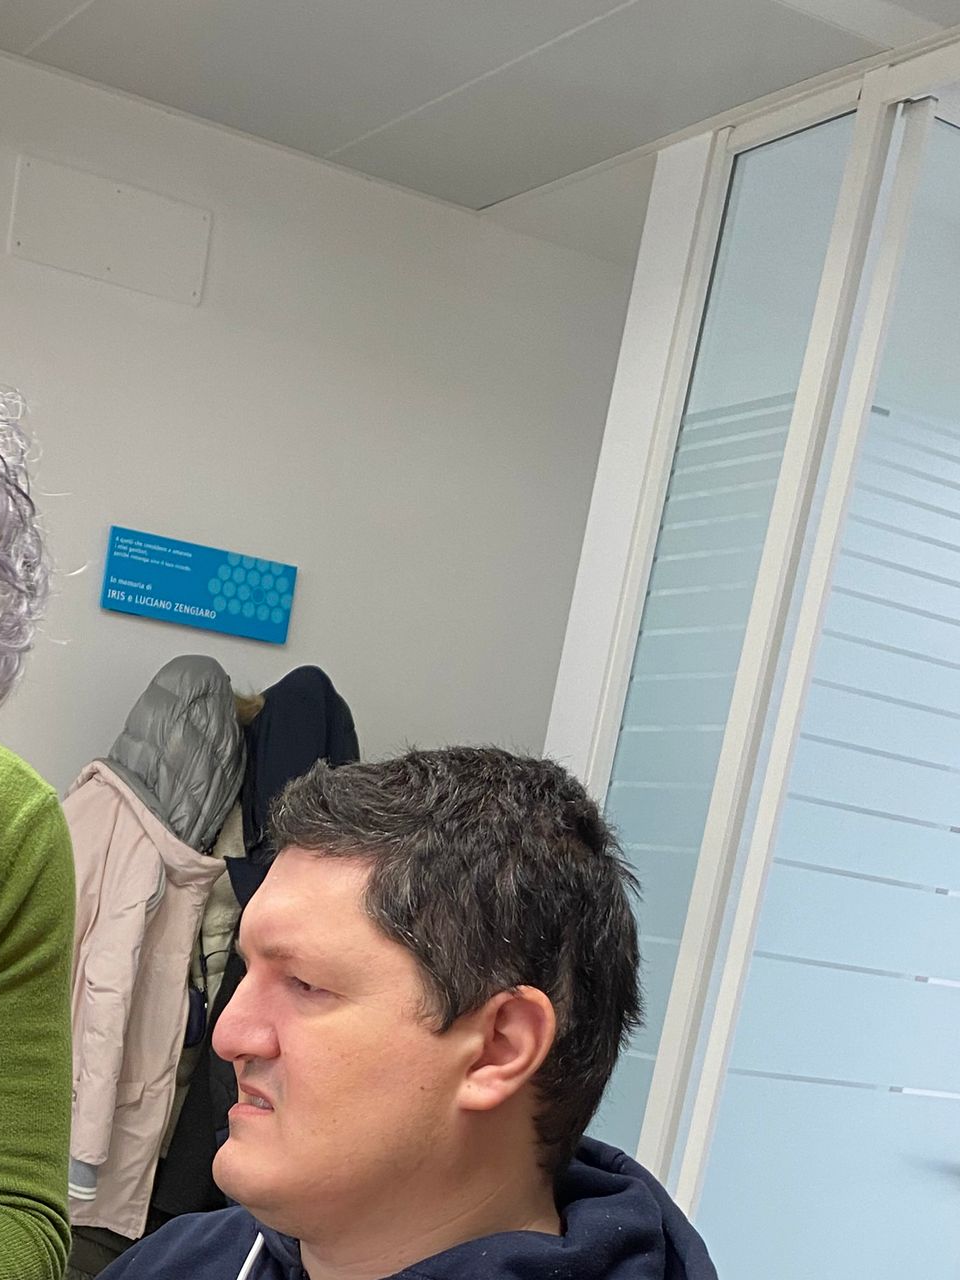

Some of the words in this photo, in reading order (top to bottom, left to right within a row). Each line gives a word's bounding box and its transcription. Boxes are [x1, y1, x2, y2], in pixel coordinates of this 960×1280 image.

[118, 578, 145, 590] memoria
[107, 589, 126, 601] IRIS
[127, 594, 133, 603] e
[135, 594, 172, 610] LUCIANO
[173, 602, 217, 619] ZENGIARO
